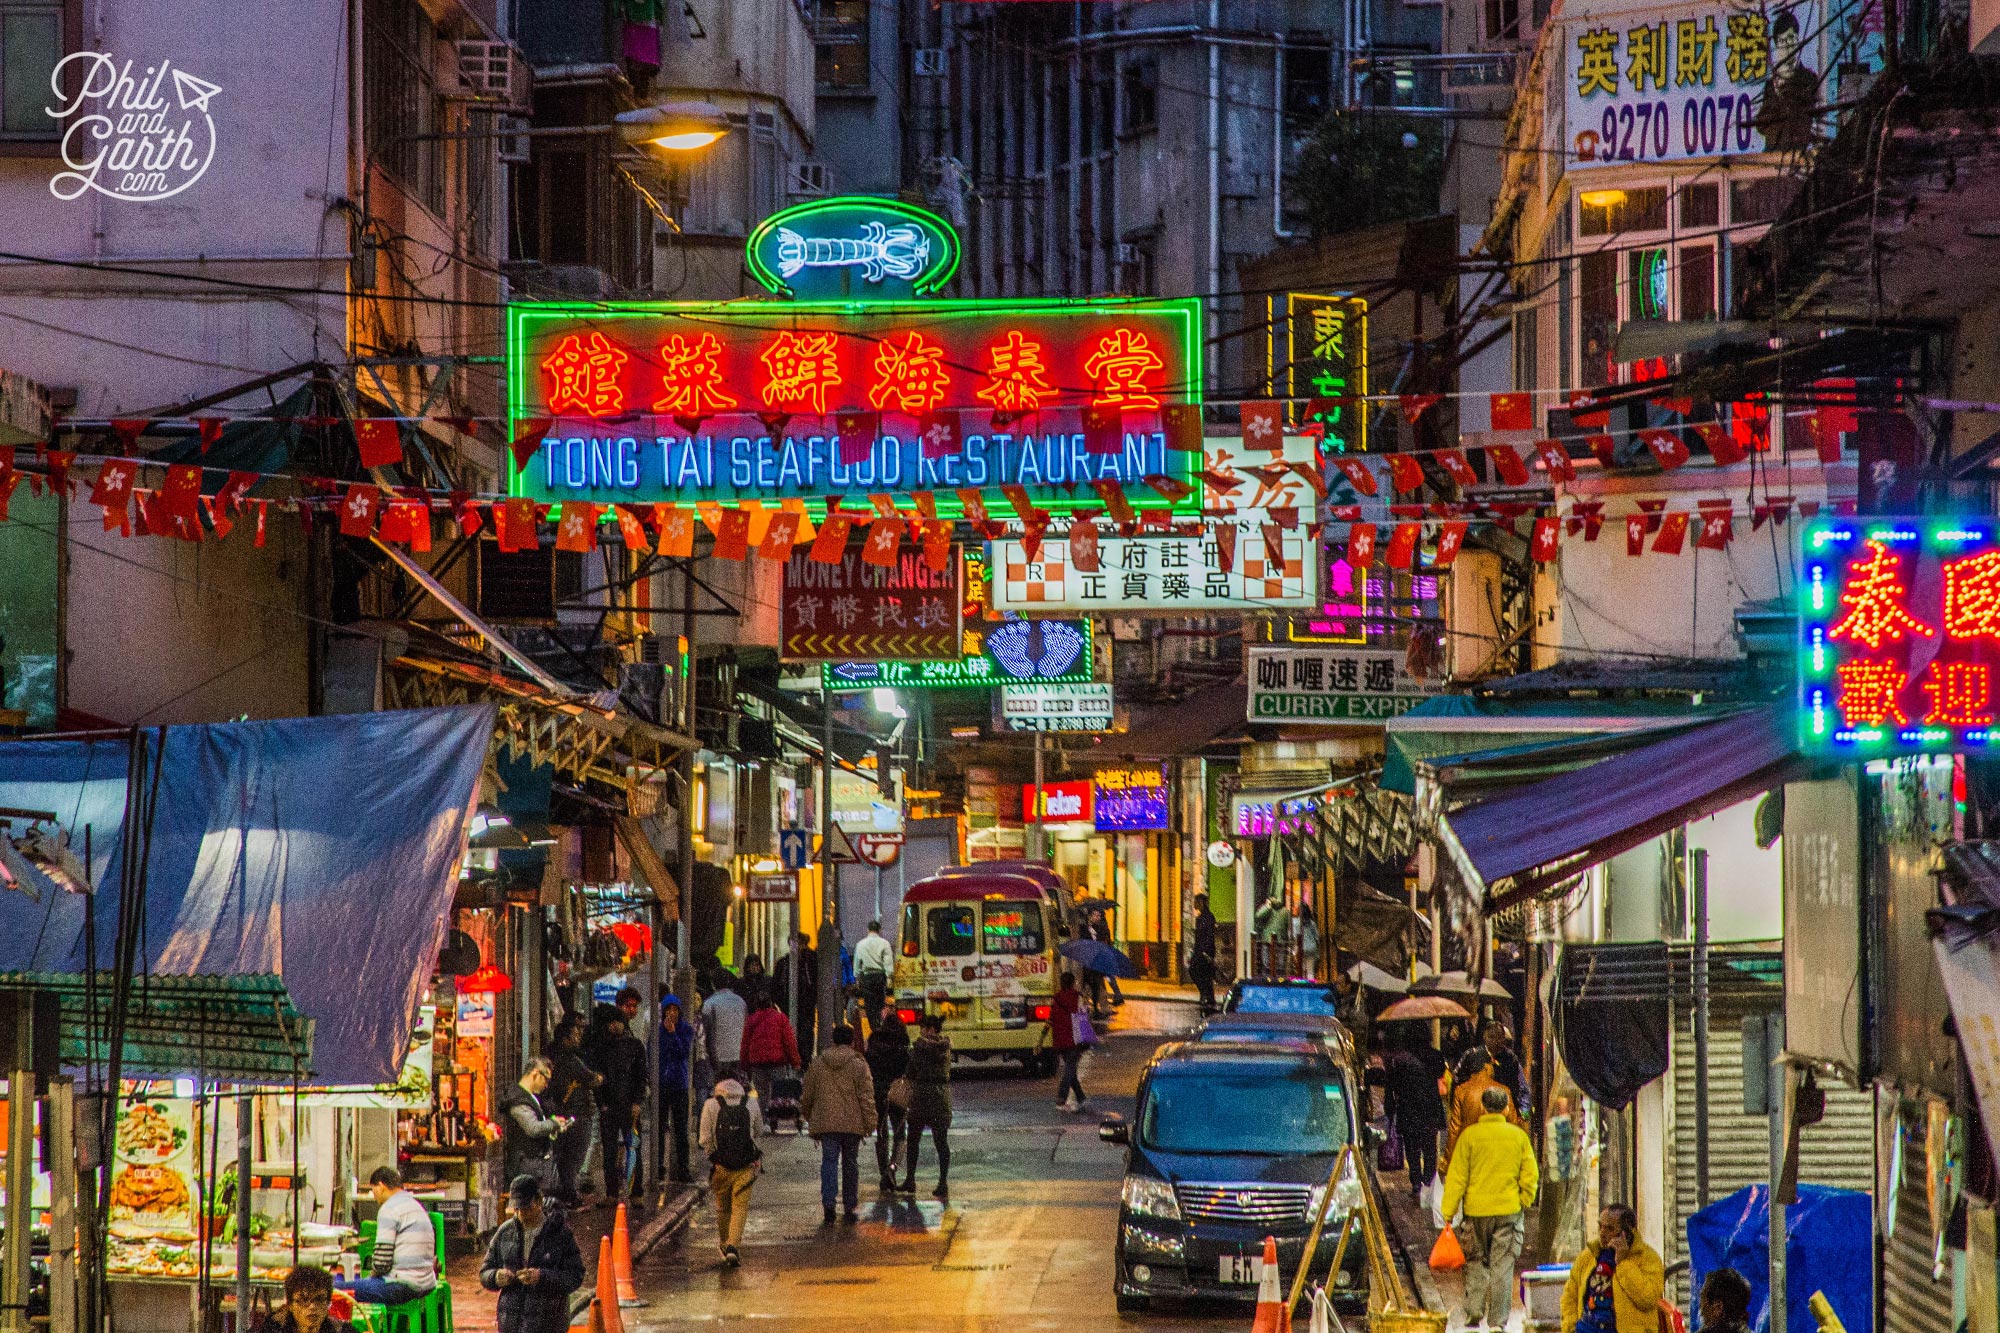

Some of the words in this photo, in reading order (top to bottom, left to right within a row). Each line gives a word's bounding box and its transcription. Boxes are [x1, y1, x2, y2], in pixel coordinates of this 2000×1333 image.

[1577, 13, 1769, 97] 英利財務
[1602, 101, 1669, 162] 9270
[1683, 92, 1751, 154] 0070
[541, 436, 639, 488] TONG
[656, 436, 714, 488] TAI
[786, 553, 856, 588] MONEY
[1081, 571, 1231, 599] 正貨藥品
[1257, 656, 1396, 693] 咖喱速遞
[1838, 659, 1992, 728] 歡迎
[1259, 695, 1339, 716] CURRY
